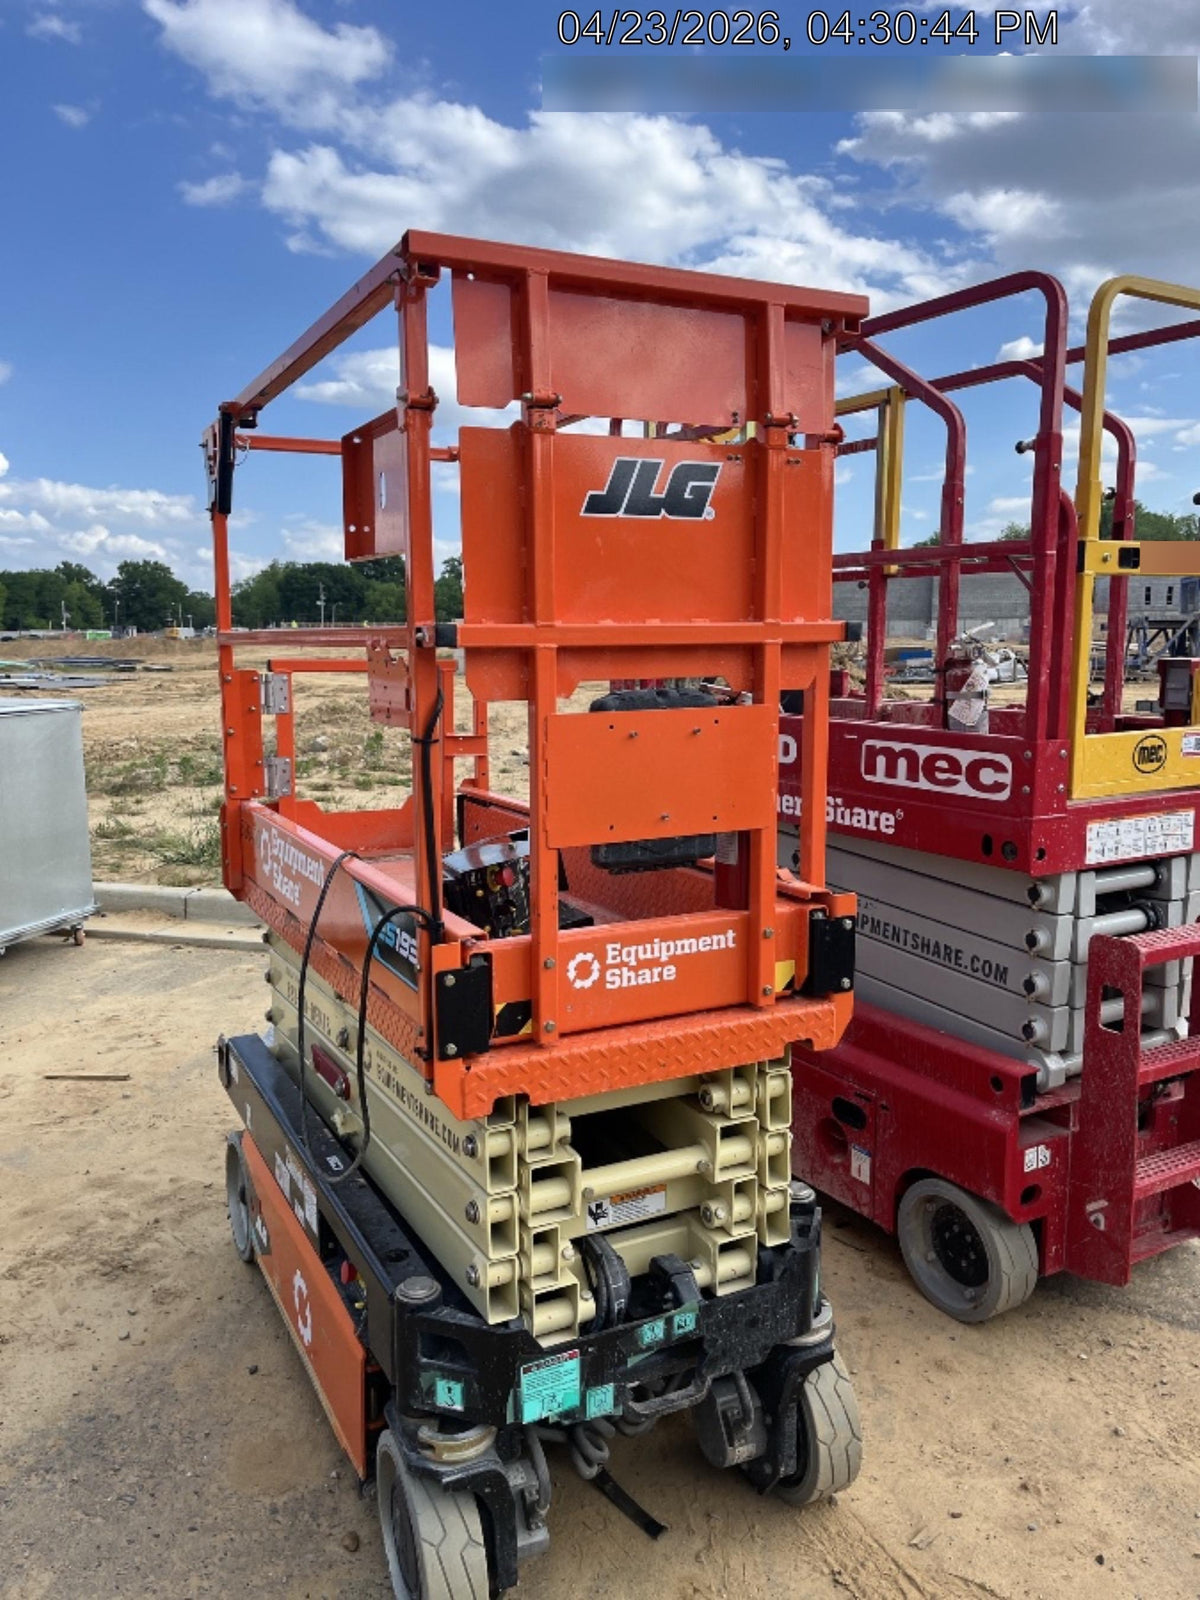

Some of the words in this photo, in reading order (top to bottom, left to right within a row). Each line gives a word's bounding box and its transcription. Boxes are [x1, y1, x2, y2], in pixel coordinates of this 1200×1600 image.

[579, 456, 723, 520] JLG
[863, 741, 1010, 796] mec
[1137, 744, 1164, 765] mec
[605, 928, 736, 966] Equipment
[605, 964, 677, 990] Share
